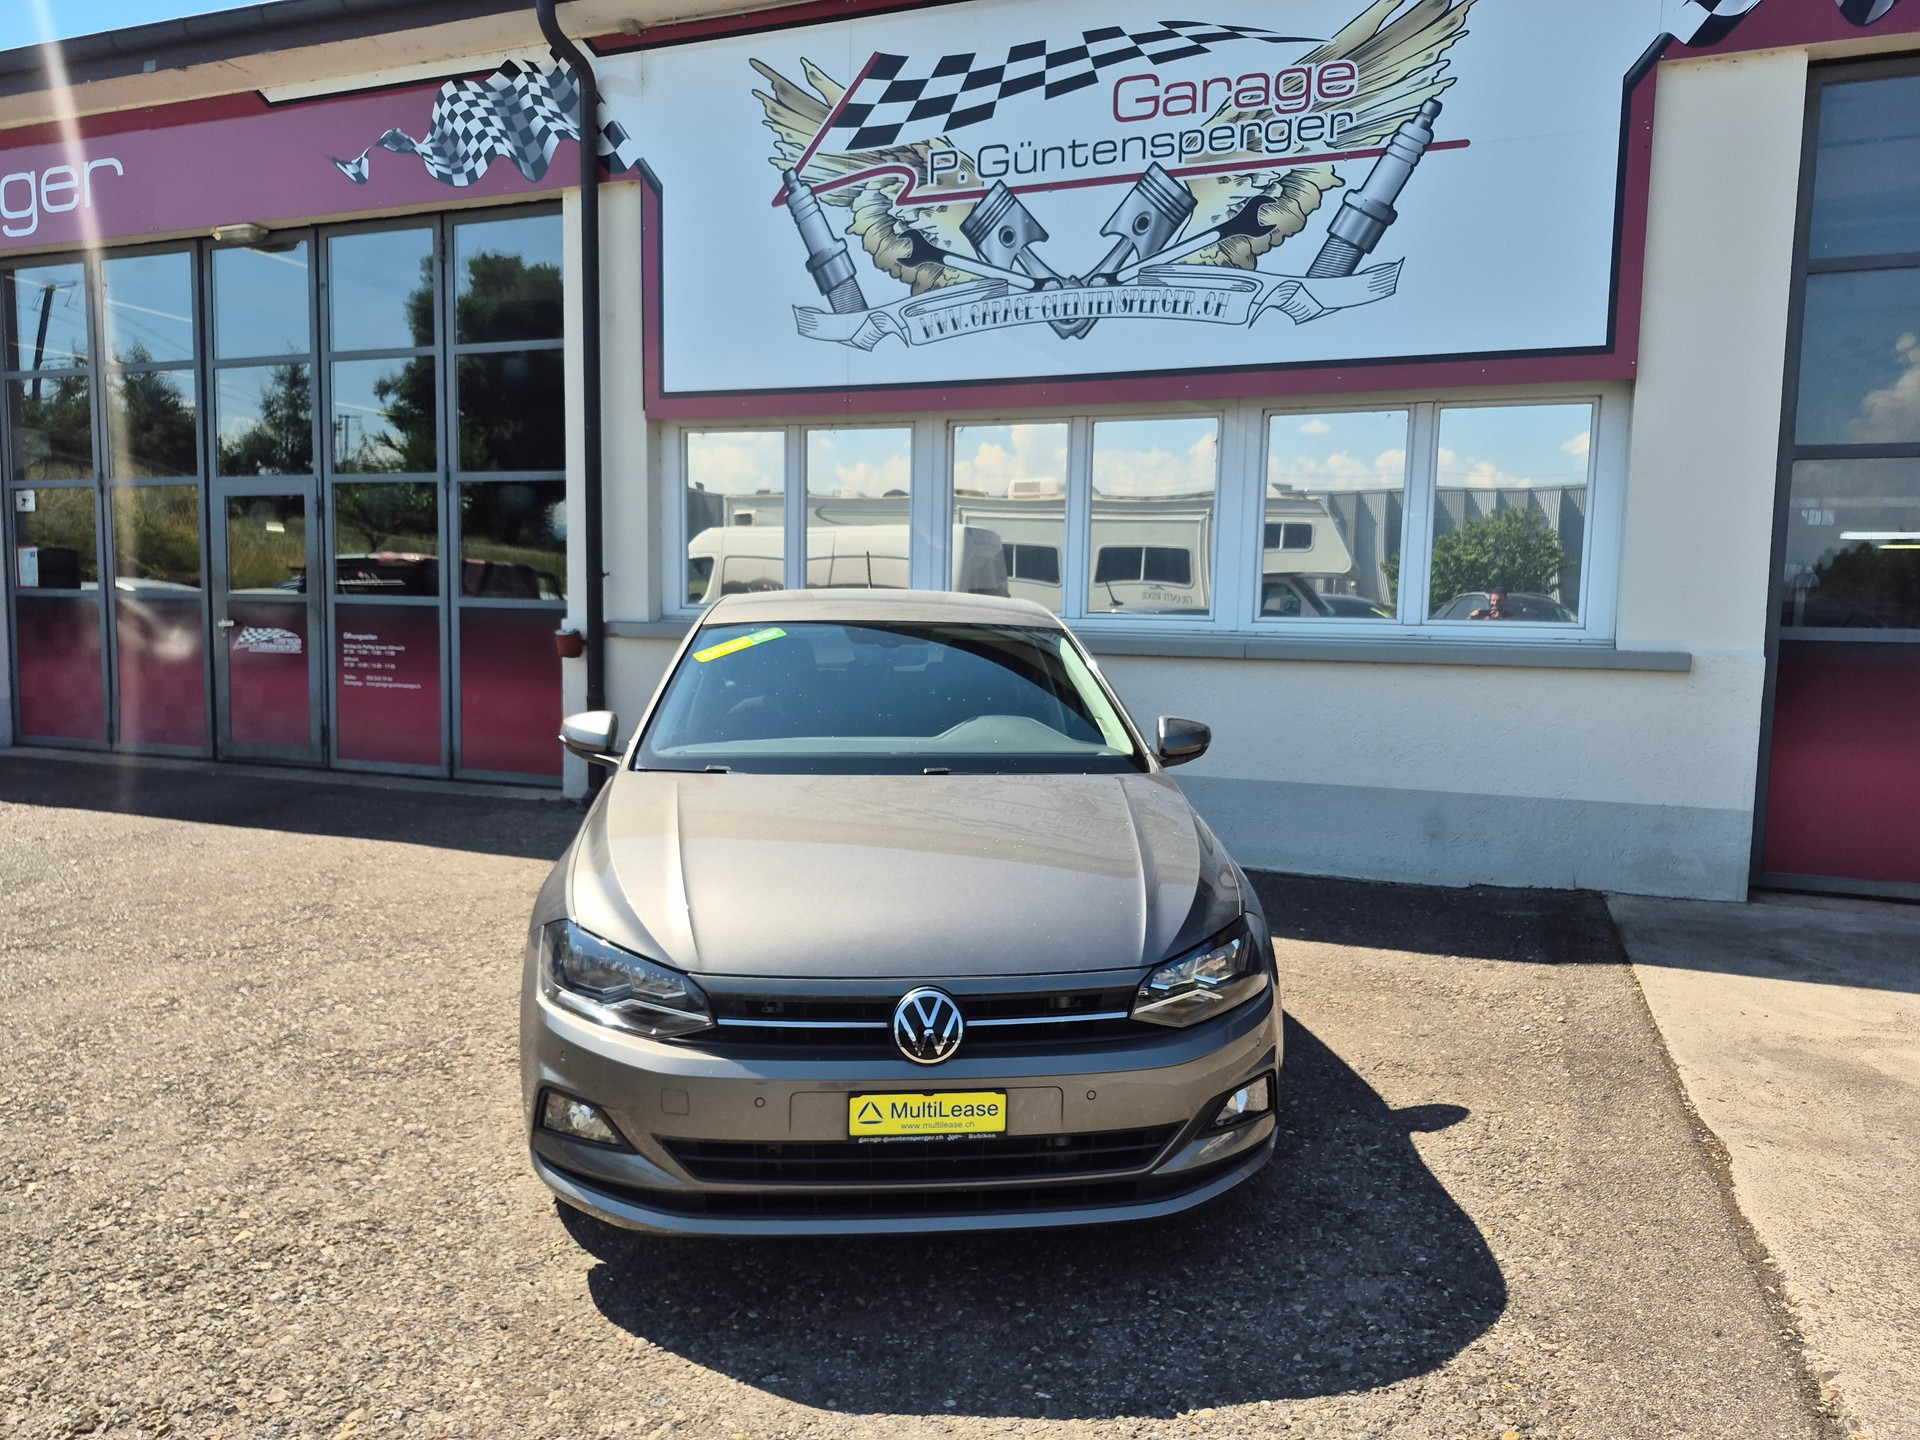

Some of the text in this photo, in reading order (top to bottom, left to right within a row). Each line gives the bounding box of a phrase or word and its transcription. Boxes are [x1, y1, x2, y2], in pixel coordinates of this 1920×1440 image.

[1113, 61, 1357, 124] Garage
[928, 109, 1354, 185] P. Güntensperger
[754, 629, 779, 641] car
[890, 1100, 999, 1119] MultiLease
[900, 1119, 975, 1130] www.multilease.ch
[968, 1132, 997, 1140] Bubikon
